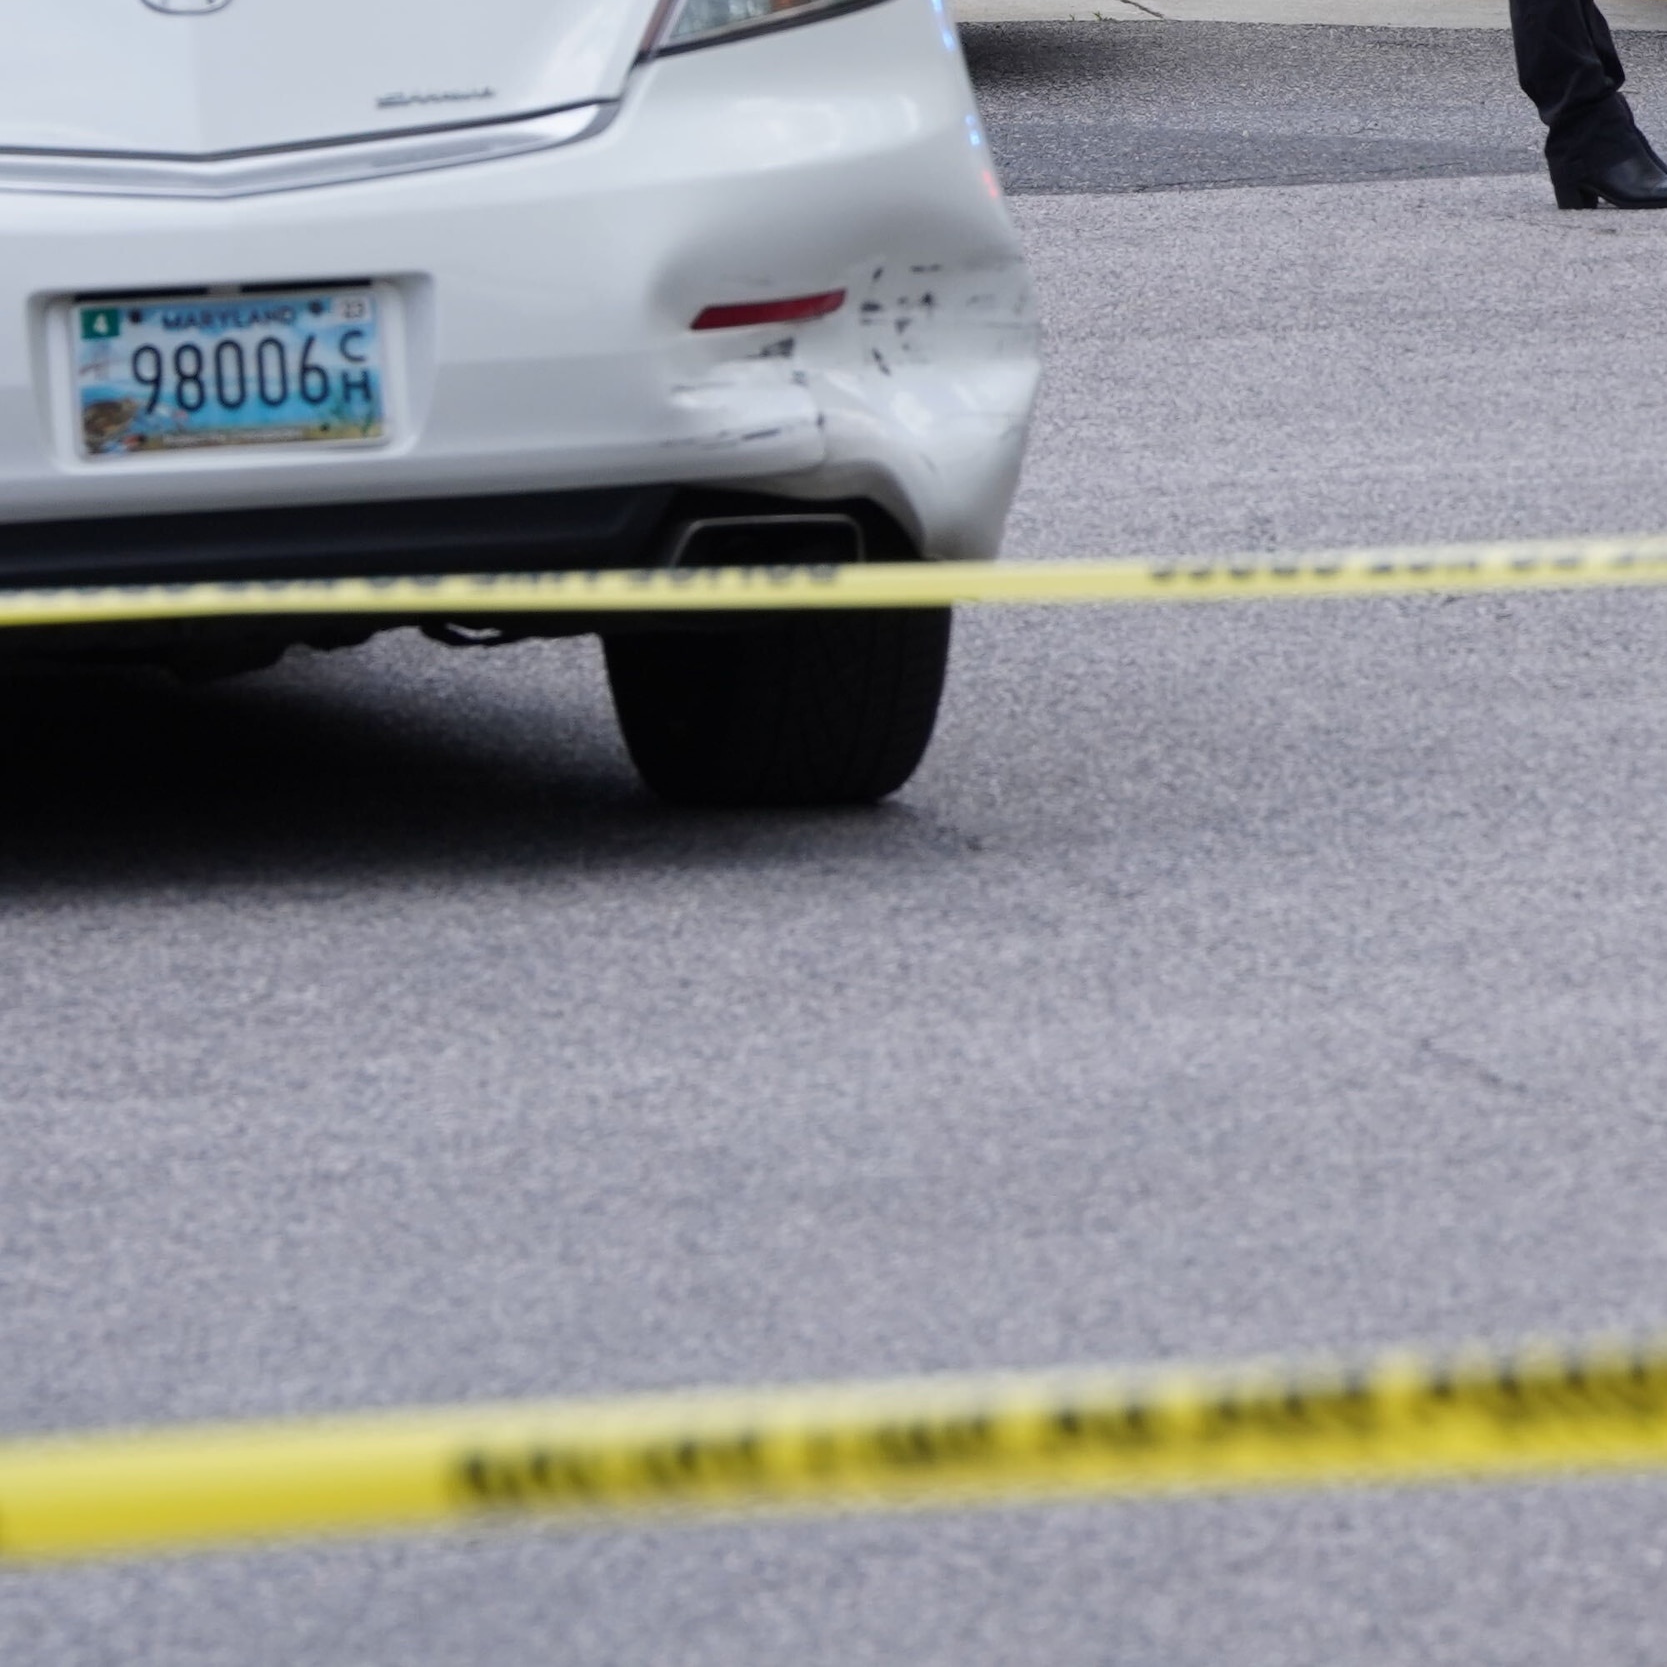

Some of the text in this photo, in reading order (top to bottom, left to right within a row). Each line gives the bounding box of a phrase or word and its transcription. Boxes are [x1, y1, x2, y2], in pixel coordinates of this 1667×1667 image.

[92, 313, 110, 333] 4
[162, 306, 296, 330] MARYLAND
[131, 334, 330, 415] 98006
